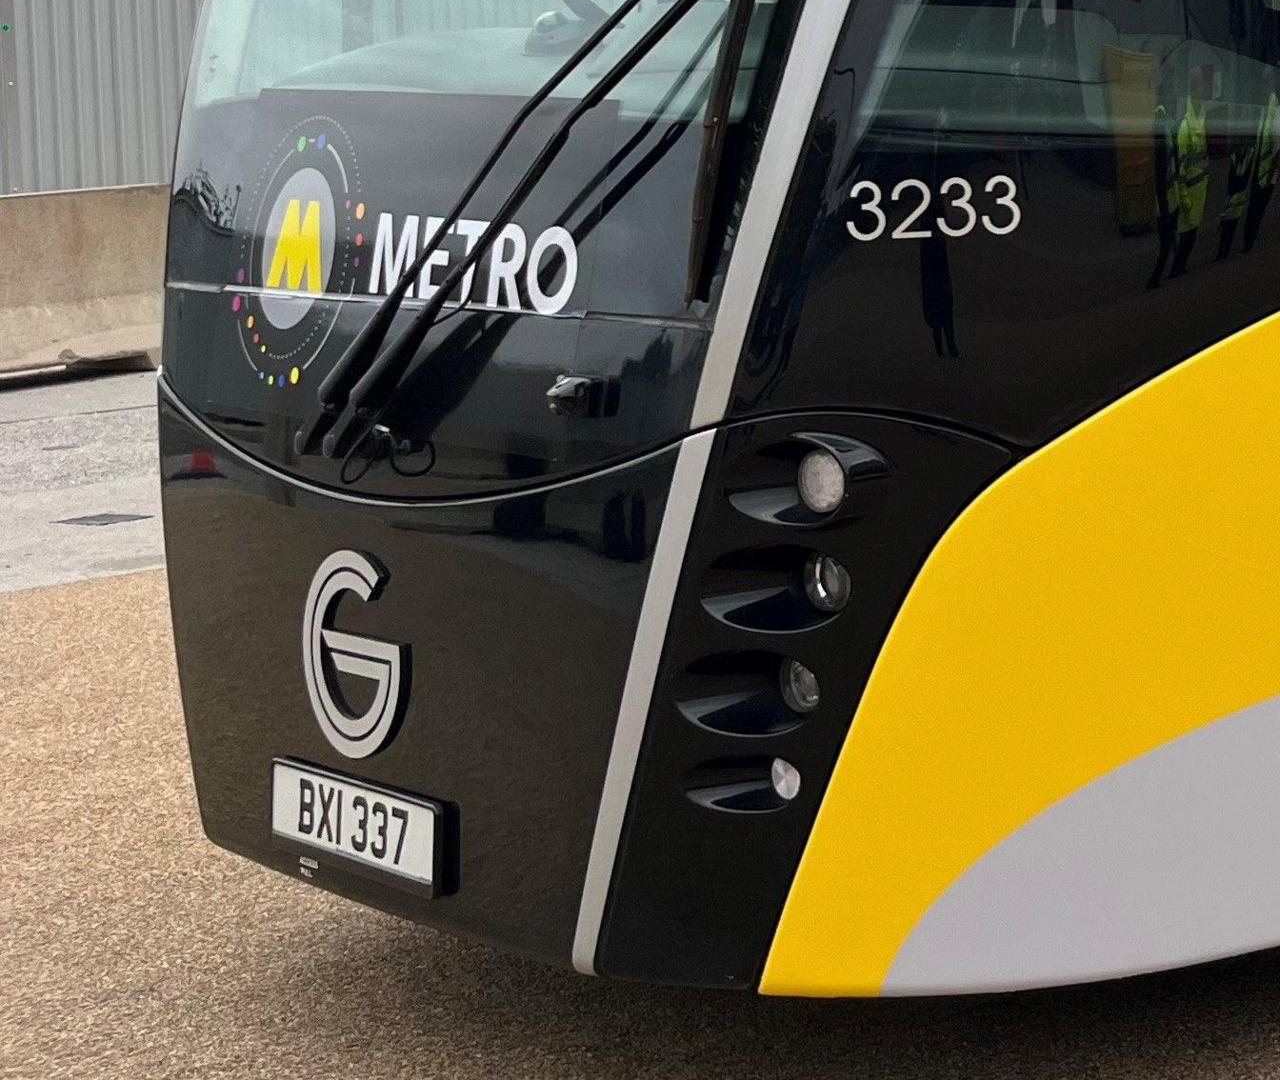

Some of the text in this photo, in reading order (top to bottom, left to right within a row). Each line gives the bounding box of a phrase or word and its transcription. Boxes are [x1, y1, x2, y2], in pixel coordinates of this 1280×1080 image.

[266, 198, 324, 294] M
[846, 175, 1022, 241] 3233
[368, 212, 579, 315] METRO
[298, 778, 409, 865] BXI 337
